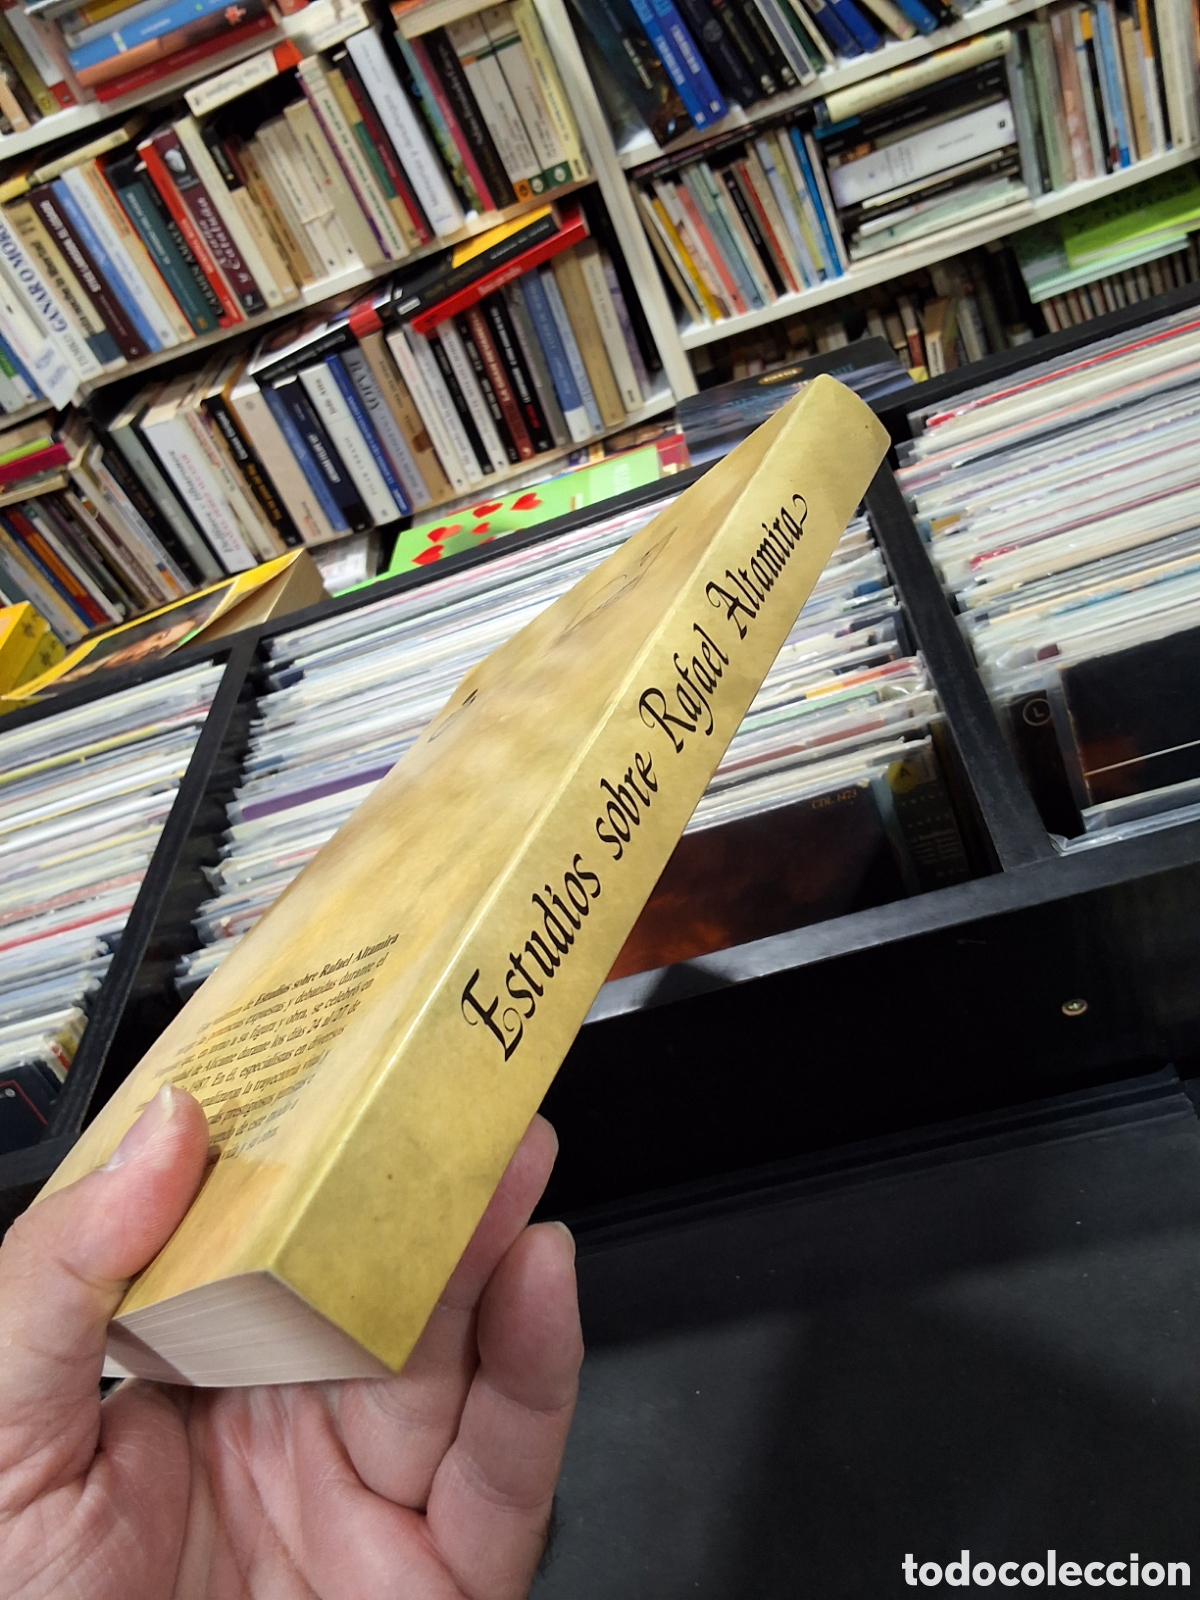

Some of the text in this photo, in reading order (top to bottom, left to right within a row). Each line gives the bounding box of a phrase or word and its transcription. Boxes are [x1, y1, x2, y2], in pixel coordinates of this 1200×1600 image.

[194, 196, 242, 271] Cataluña
[17, 266, 36, 284] O
[26, 280, 68, 335] GANAR
[488, 362, 507, 389] GRAN
[461, 853, 601, 1062] Estudios
[596, 751, 653, 860] sobre
[638, 623, 730, 755] Rafael
[705, 493, 808, 639] Altamira
[254, 983, 292, 1007] Estudios
[291, 972, 319, 991] sobre
[318, 952, 354, 979] Rafael
[352, 933, 399, 964] Altamira
[338, 961, 376, 986] durante
[375, 951, 390, 968] el
[249, 1024, 278, 1041] figura
[311, 1002, 324, 1015] se
[306, 1017, 323, 1034] 24
[293, 1043, 308, 1057] en
